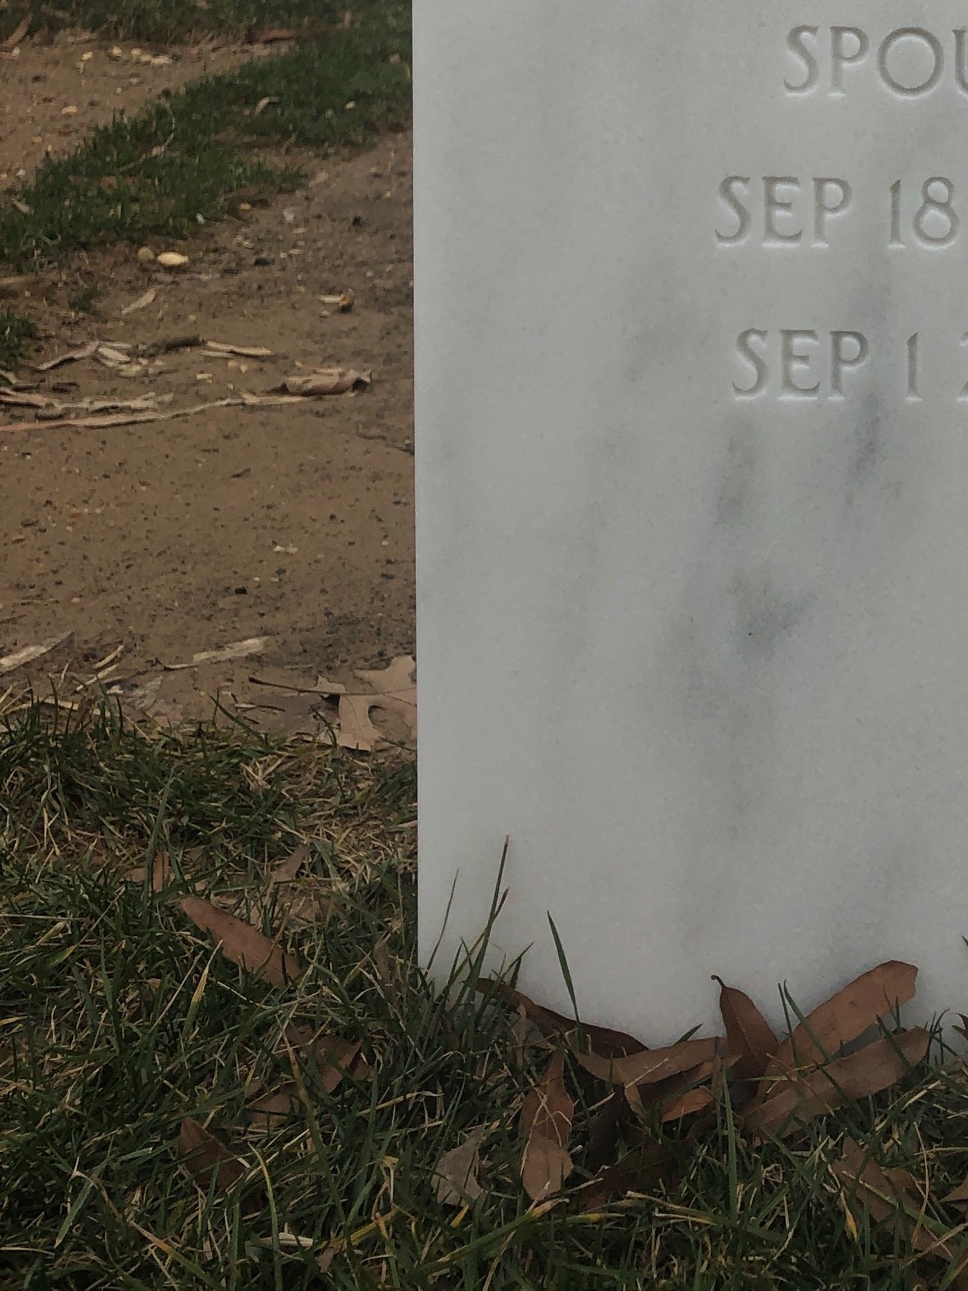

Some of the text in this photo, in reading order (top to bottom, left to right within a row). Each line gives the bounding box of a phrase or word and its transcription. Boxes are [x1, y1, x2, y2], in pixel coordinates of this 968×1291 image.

[714, 175, 853, 248] SEP
[887, 175, 960, 250] 18
[732, 327, 870, 402] SEP
[904, 330, 924, 403] 1
